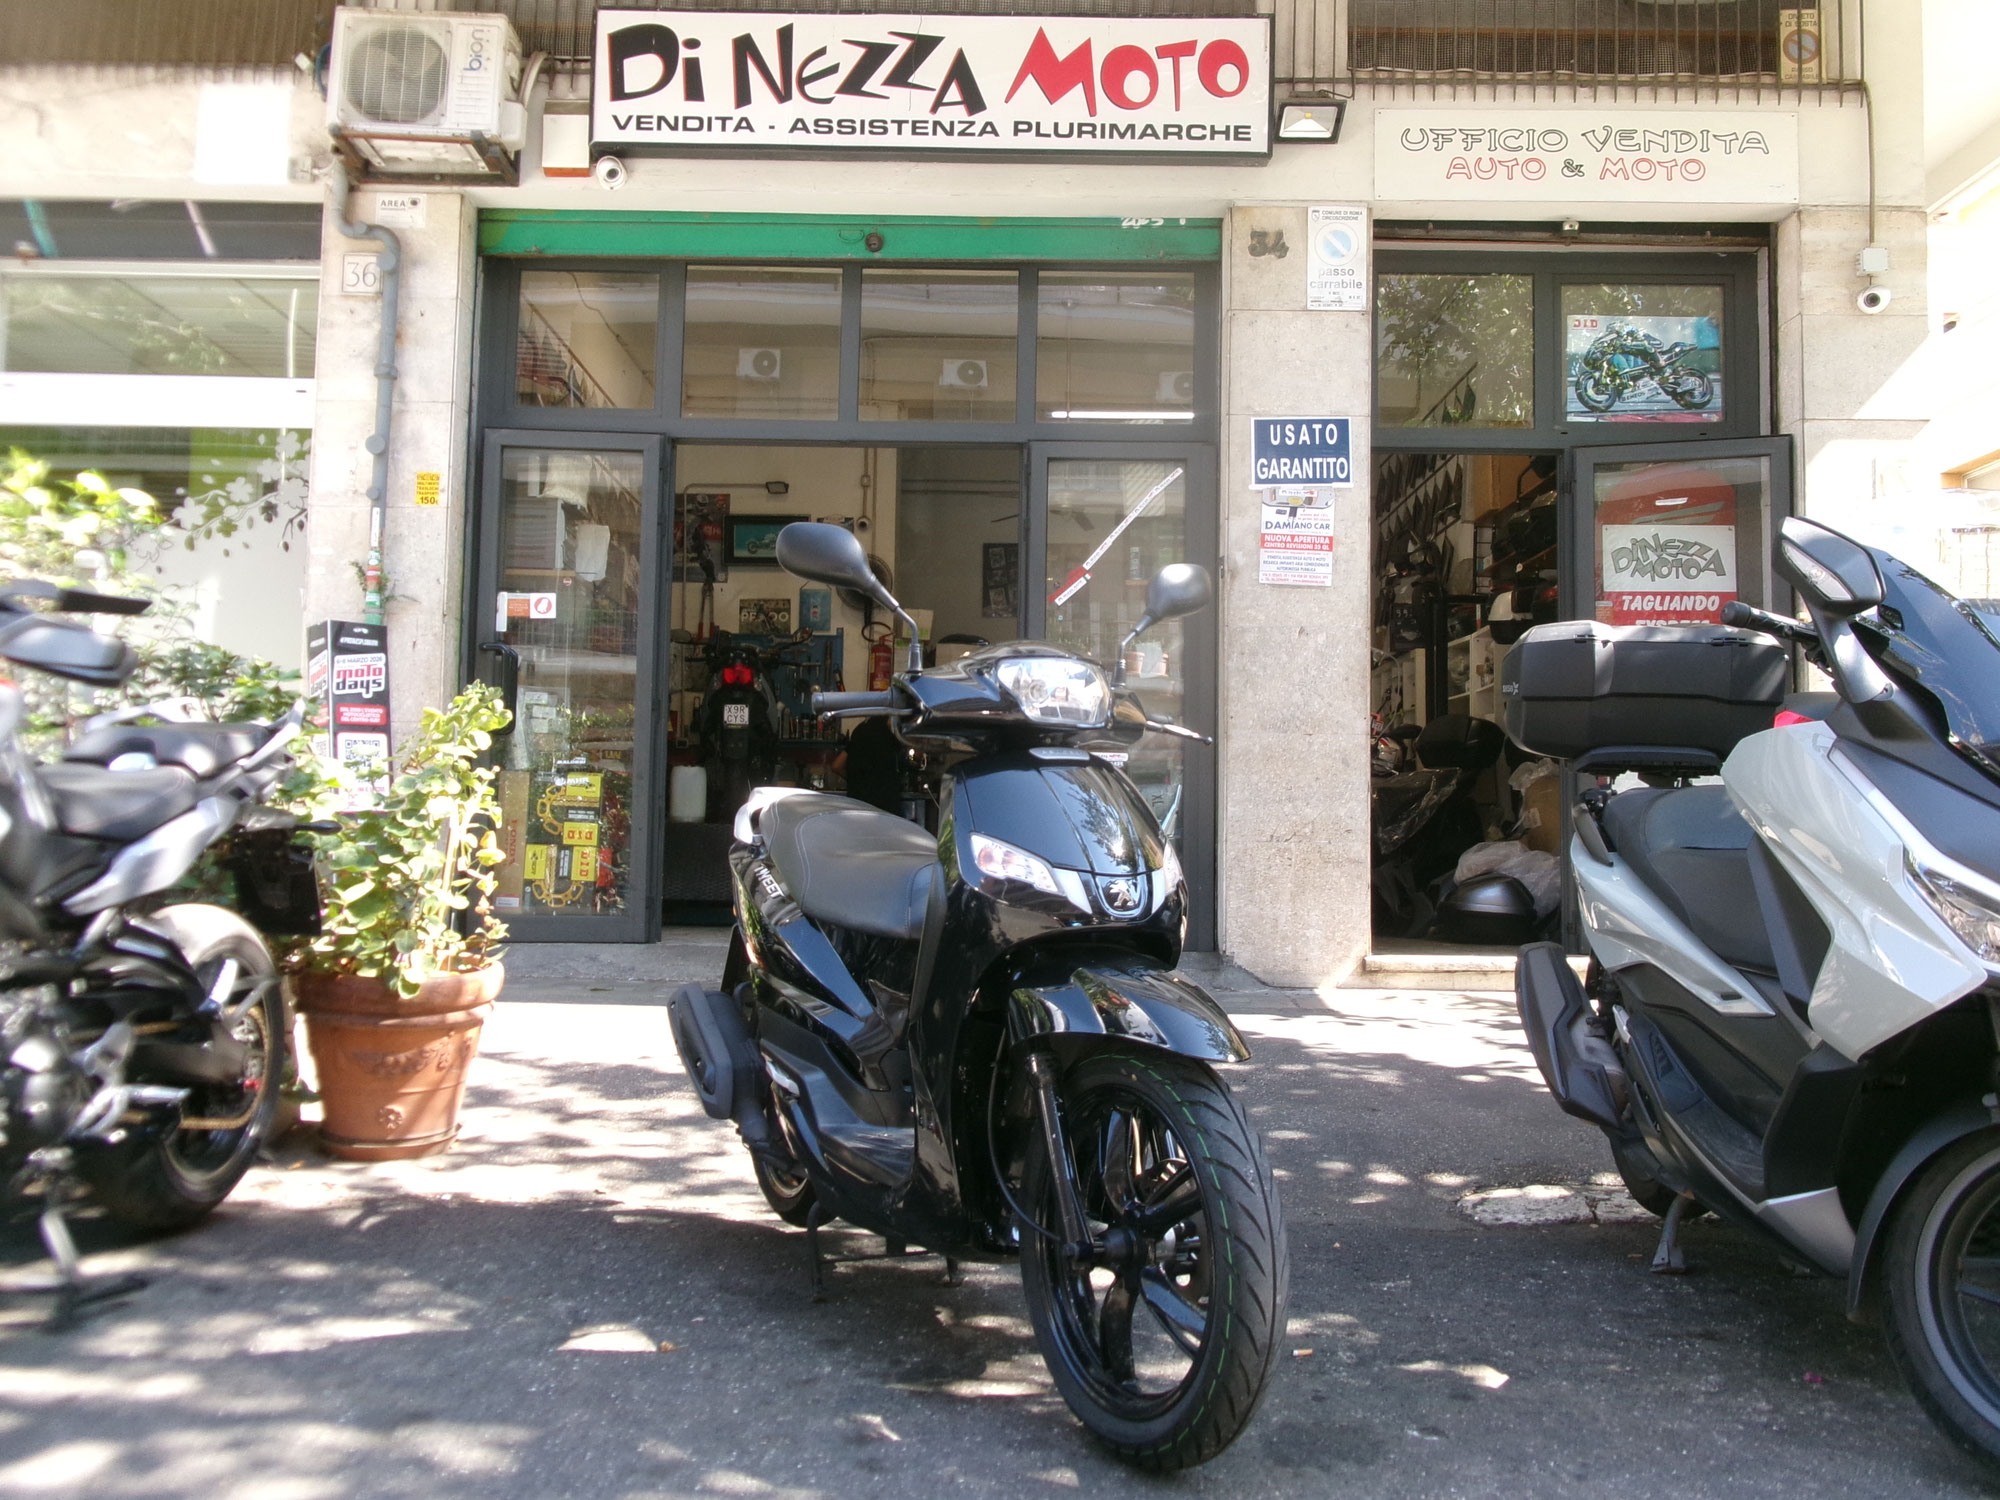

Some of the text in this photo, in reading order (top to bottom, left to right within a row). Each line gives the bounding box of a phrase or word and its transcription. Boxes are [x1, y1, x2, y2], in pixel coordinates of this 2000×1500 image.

[1004, 26, 1250, 118] MOTO
[611, 114, 755, 135] VENDITA
[789, 116, 1000, 138] ASSISTENZA
[1013, 121, 1253, 142] PLURIMARCHE
[1400, 126, 1770, 156] UFFICIO VENDITA
[1446, 156, 1547, 181] AUTO
[1599, 157, 1706, 182] MOTO
[346, 261, 377, 288] 36
[1318, 268, 1355, 278] passo
[1310, 278, 1362, 289] carrabile
[1270, 423, 1337, 446] USATO
[1256, 457, 1348, 481] GARANTITO
[1264, 520, 1330, 530] DAMIANO CAR
[1264, 534, 1330, 544] NUOVA APERTURA
[1622, 596, 1720, 611] TAGLIANDO
[336, 678, 382, 694] days
[726, 714, 745, 723] CYS
[727, 706, 745, 714] X9R
[754, 865, 785, 898] TWEET
